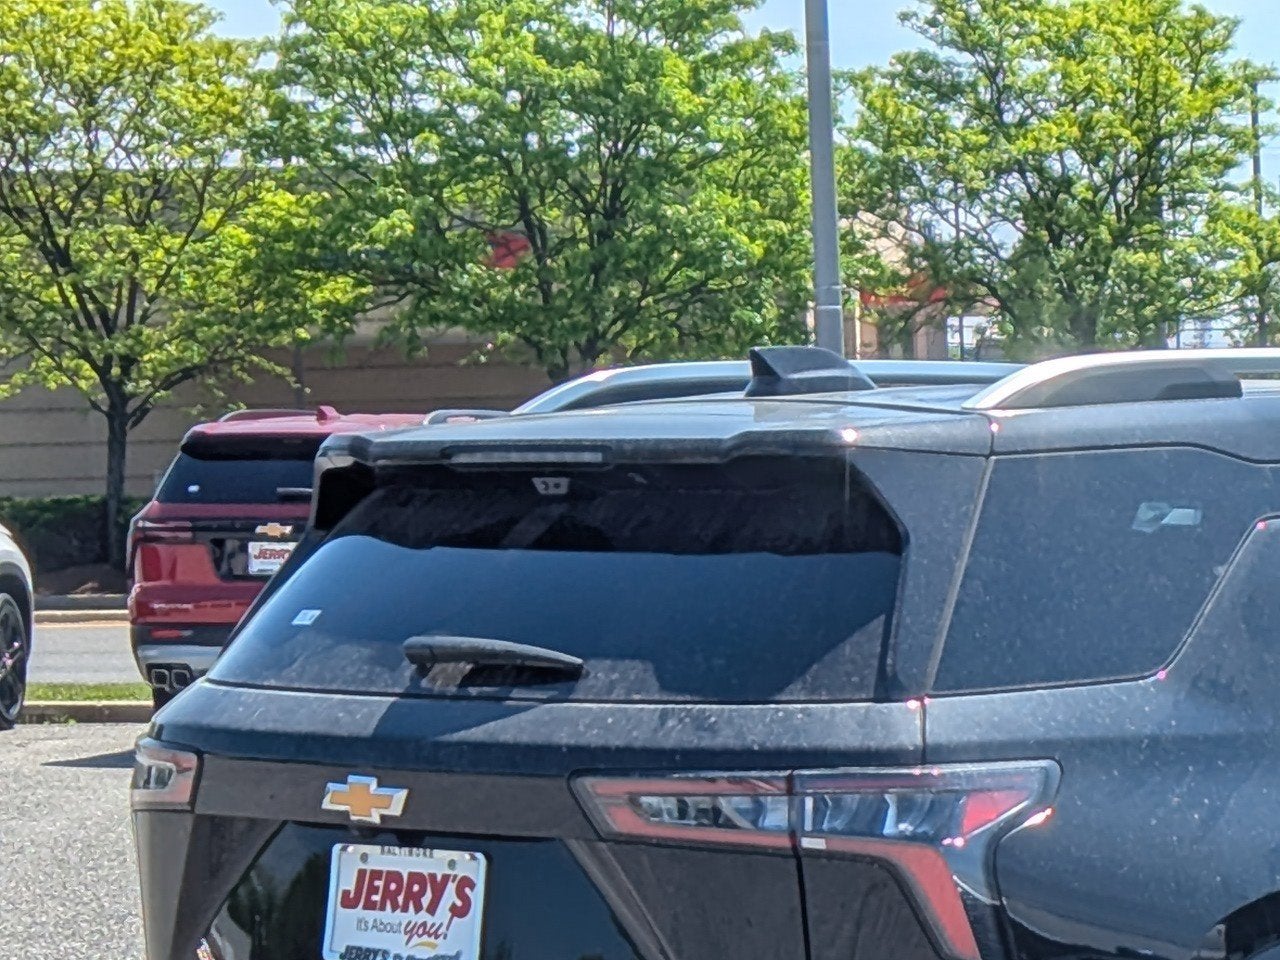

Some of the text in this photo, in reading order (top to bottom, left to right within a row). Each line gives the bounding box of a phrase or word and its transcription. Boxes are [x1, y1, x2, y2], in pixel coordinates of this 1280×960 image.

[340, 868, 477, 919] JERRY'S
[356, 917, 370, 932] It's
[370, 918, 402, 935] About
